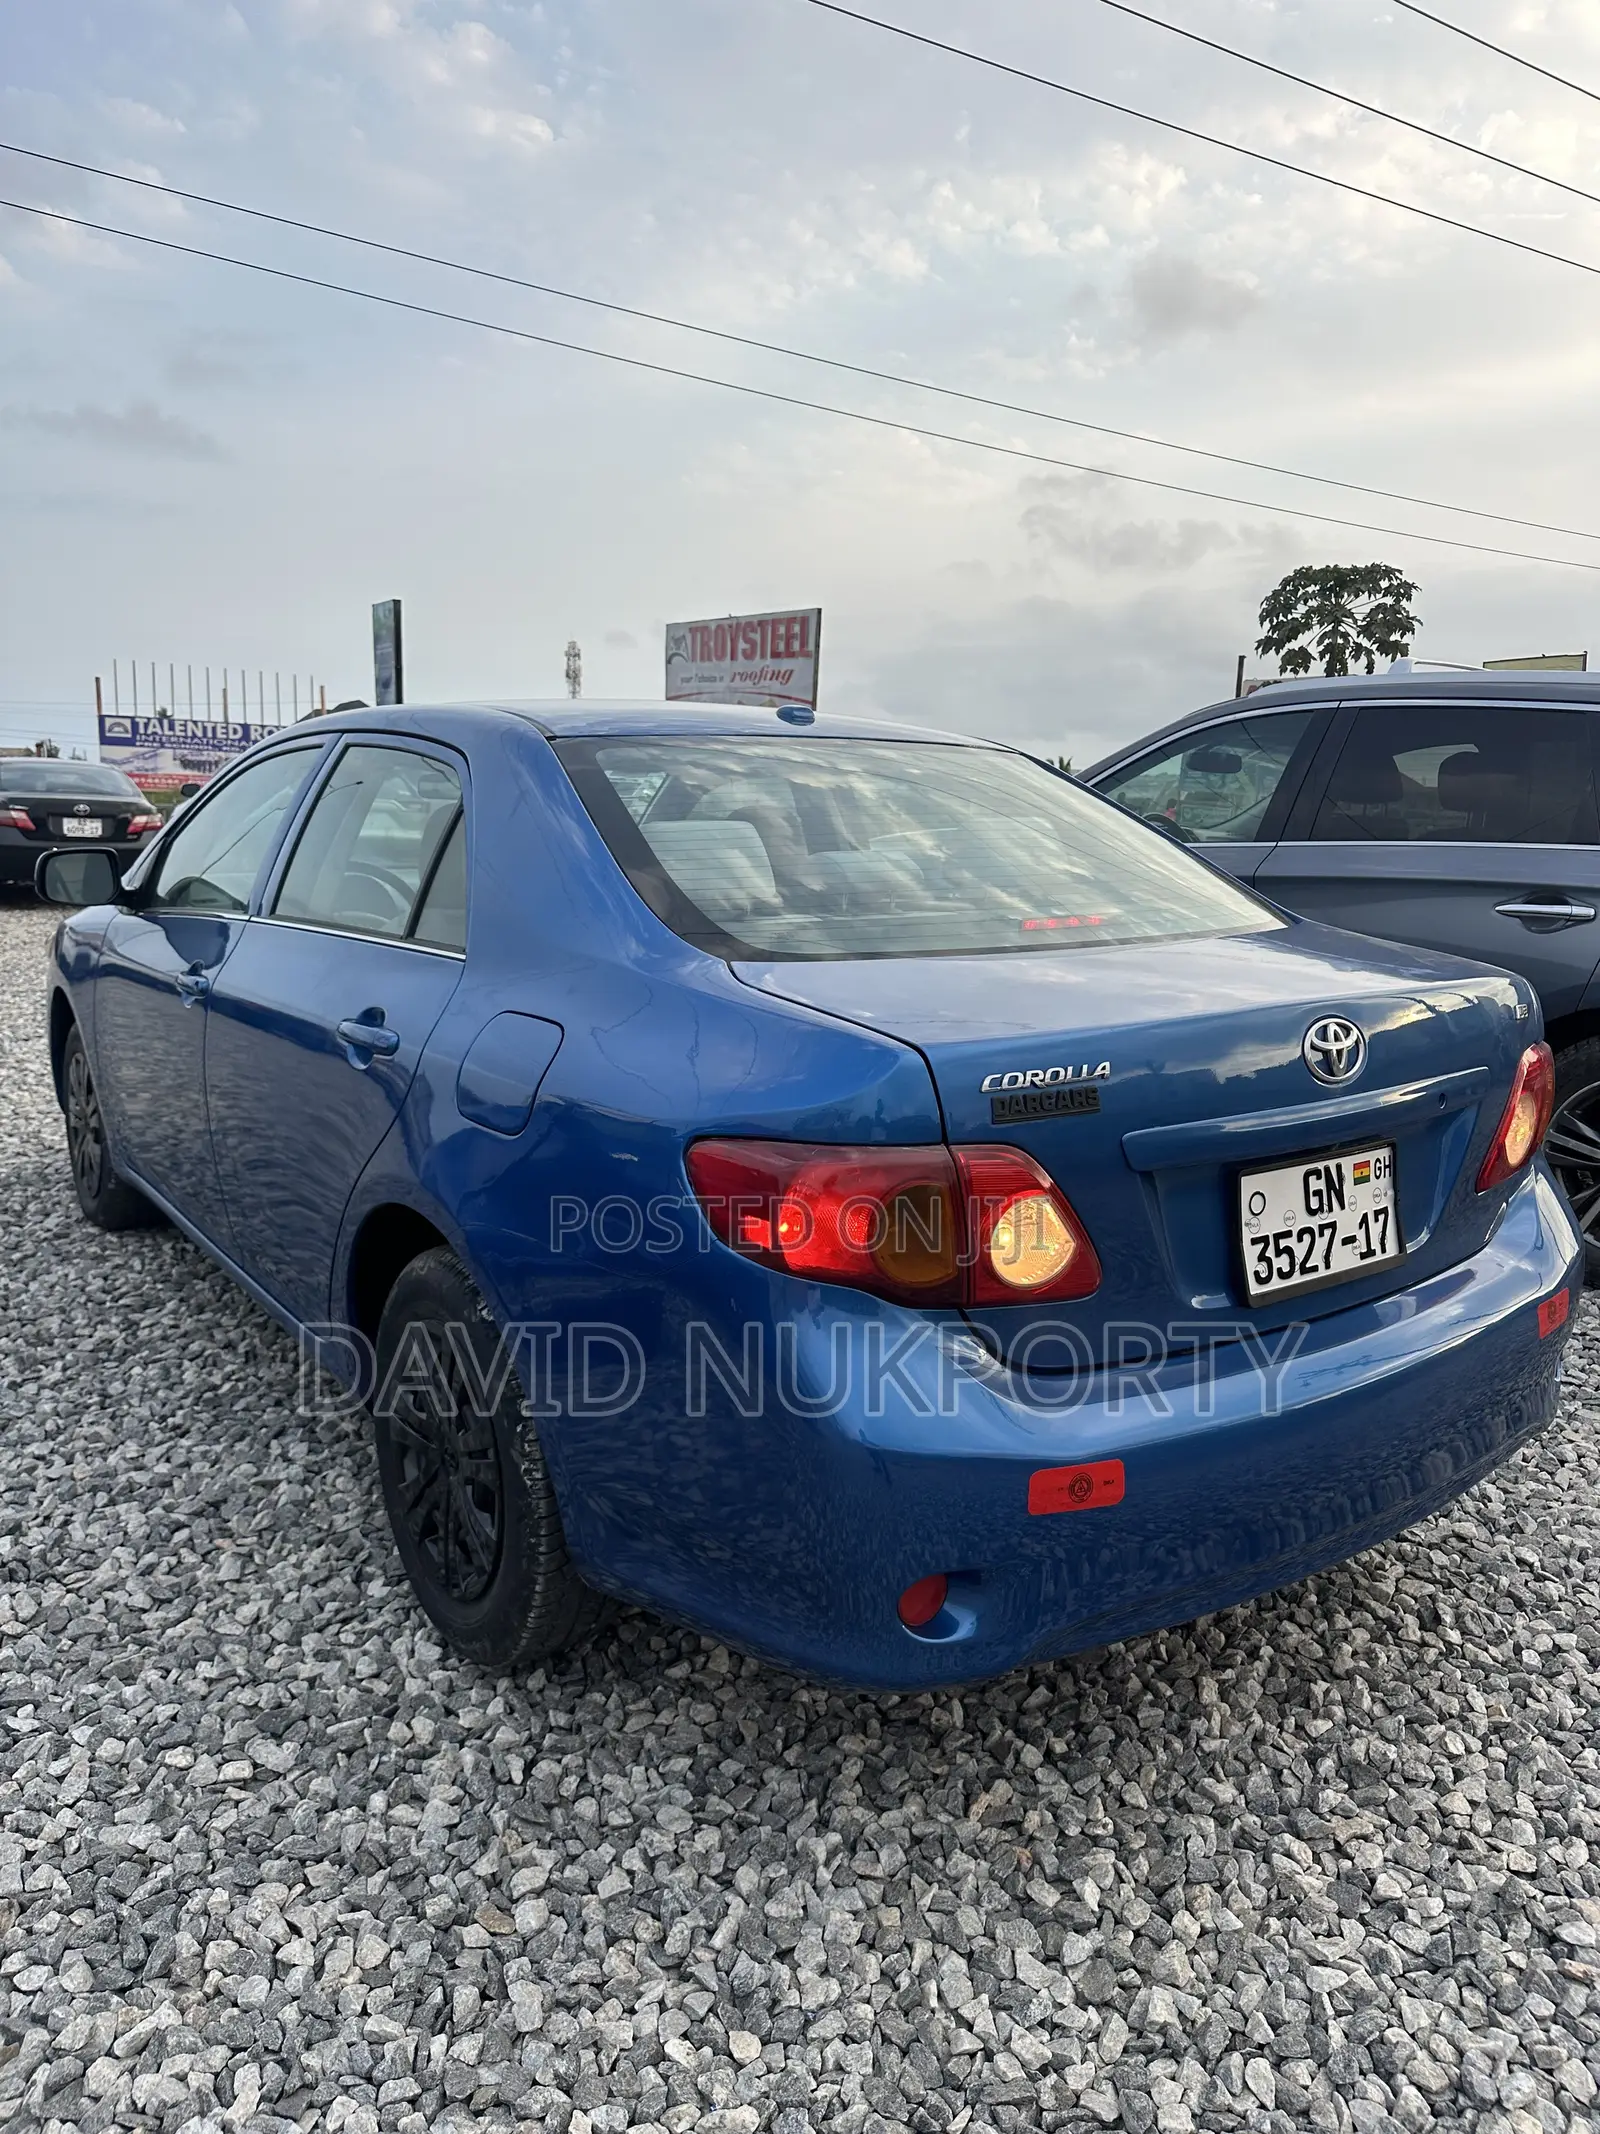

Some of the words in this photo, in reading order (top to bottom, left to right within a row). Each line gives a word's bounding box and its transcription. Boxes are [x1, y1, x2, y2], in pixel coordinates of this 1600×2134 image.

[688, 615, 813, 663] TROYSTEEL
[730, 665, 795, 686] roofing
[135, 717, 244, 740] TALENTED
[250, 725, 288, 741] RO
[980, 1061, 1111, 1093] COROLLA
[1303, 1162, 1346, 1217] GN
[1374, 1155, 1392, 1180] GH
[1250, 1205, 1389, 1285] 3527-17
